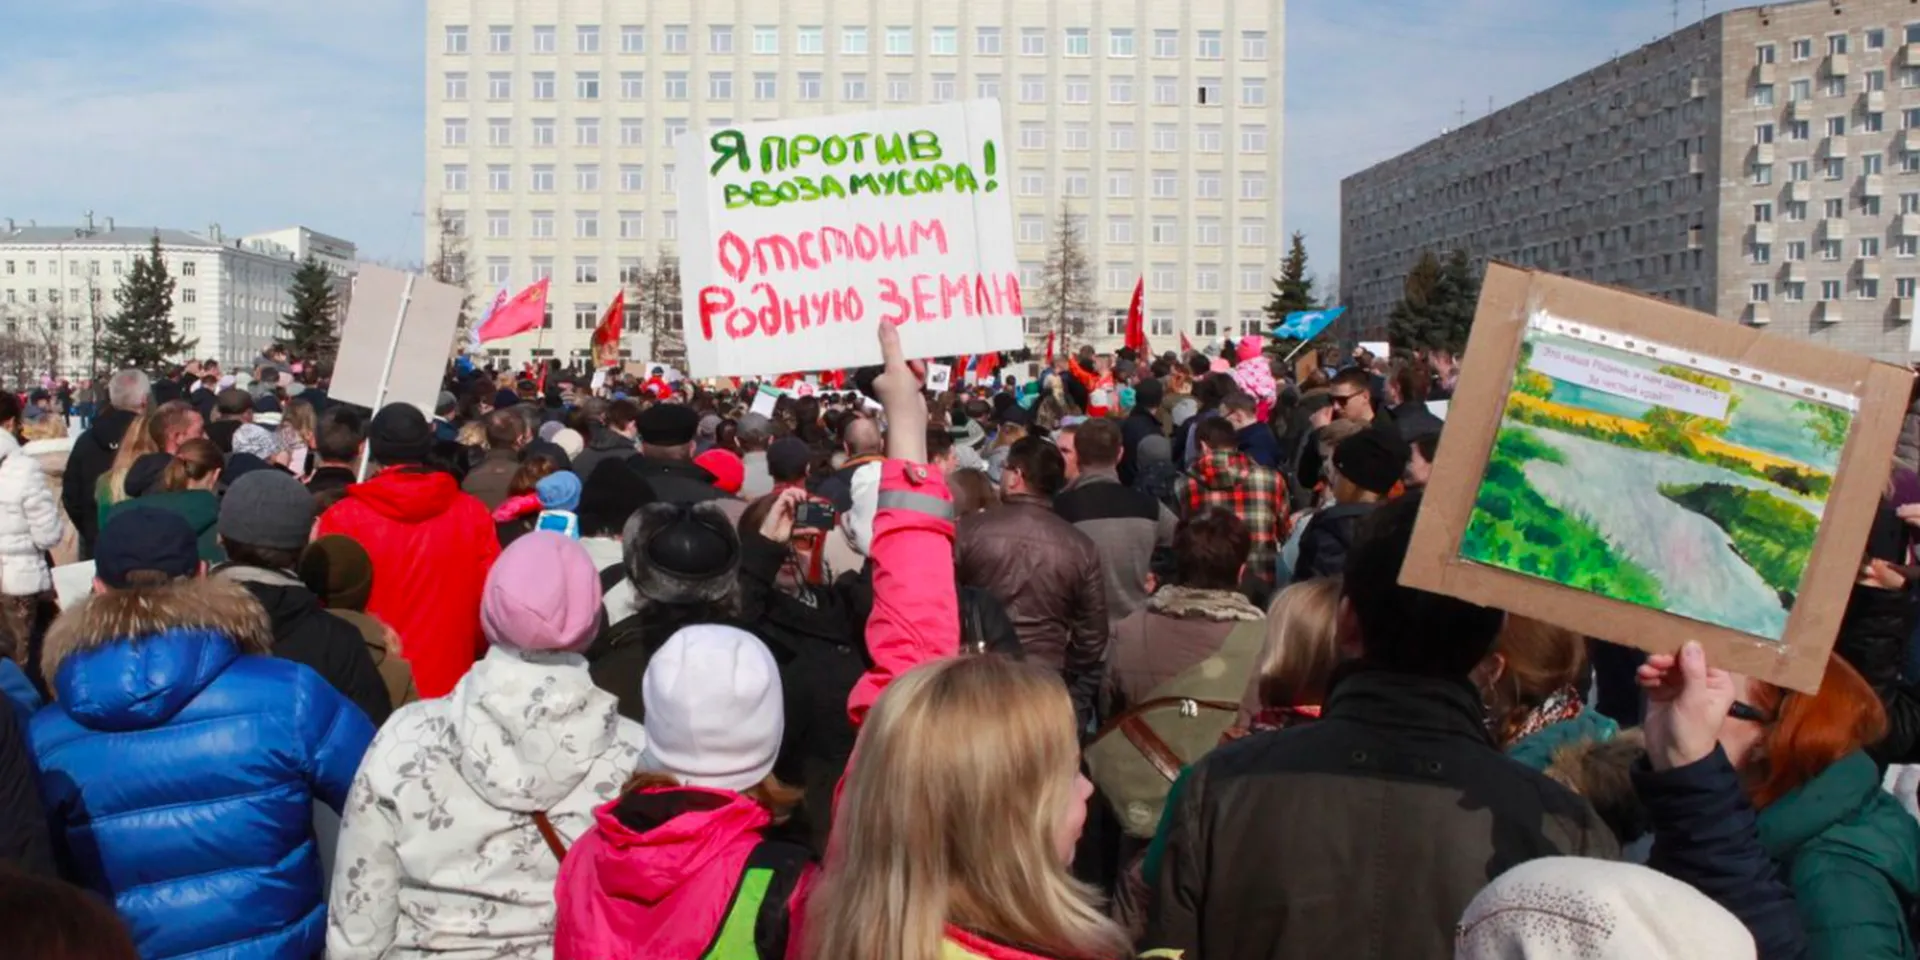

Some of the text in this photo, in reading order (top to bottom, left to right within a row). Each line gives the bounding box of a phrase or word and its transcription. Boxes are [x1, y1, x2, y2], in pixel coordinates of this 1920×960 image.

[711, 129, 942, 175] Я ПРОТИВ
[724, 175, 846, 209] ВВОЗА
